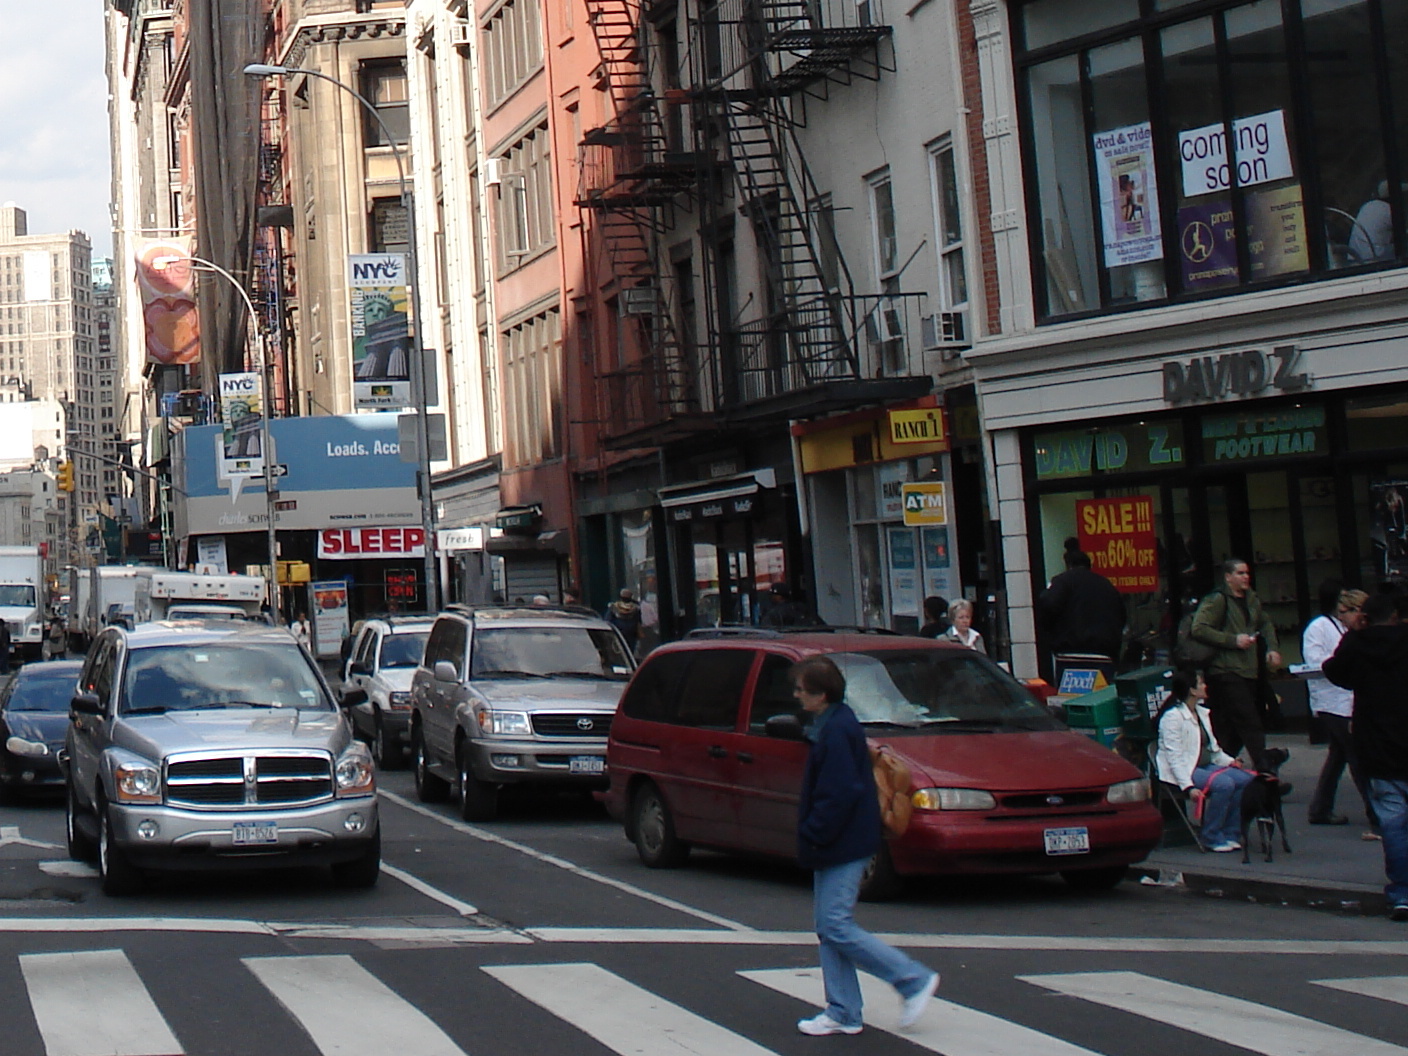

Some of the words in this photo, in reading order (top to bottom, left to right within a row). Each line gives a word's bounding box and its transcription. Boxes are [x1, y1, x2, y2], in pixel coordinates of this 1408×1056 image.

[1095, 135, 1115, 150] dvd
[1117, 133, 1126, 144] &
[1205, 157, 1268, 189] soon
[353, 262, 400, 280] NYC
[352, 290, 366, 337] BANKING
[223, 380, 253, 391] NYC
[1163, 350, 1269, 402] DAVID
[894, 421, 928, 439] RANCH
[326, 441, 369, 457] Loads.
[1035, 432, 1128, 475] DAVID
[1147, 426, 1182, 464] Z.
[1215, 431, 1315, 460] FOOTWEAR
[906, 494, 942, 509] ATM
[1083, 503, 1134, 535] SALE
[322, 528, 438, 554] SLEEP
[1108, 538, 1136, 568] 60%
[1138, 549, 1154, 567] OFF
[1063, 671, 1095, 693] Epoch
